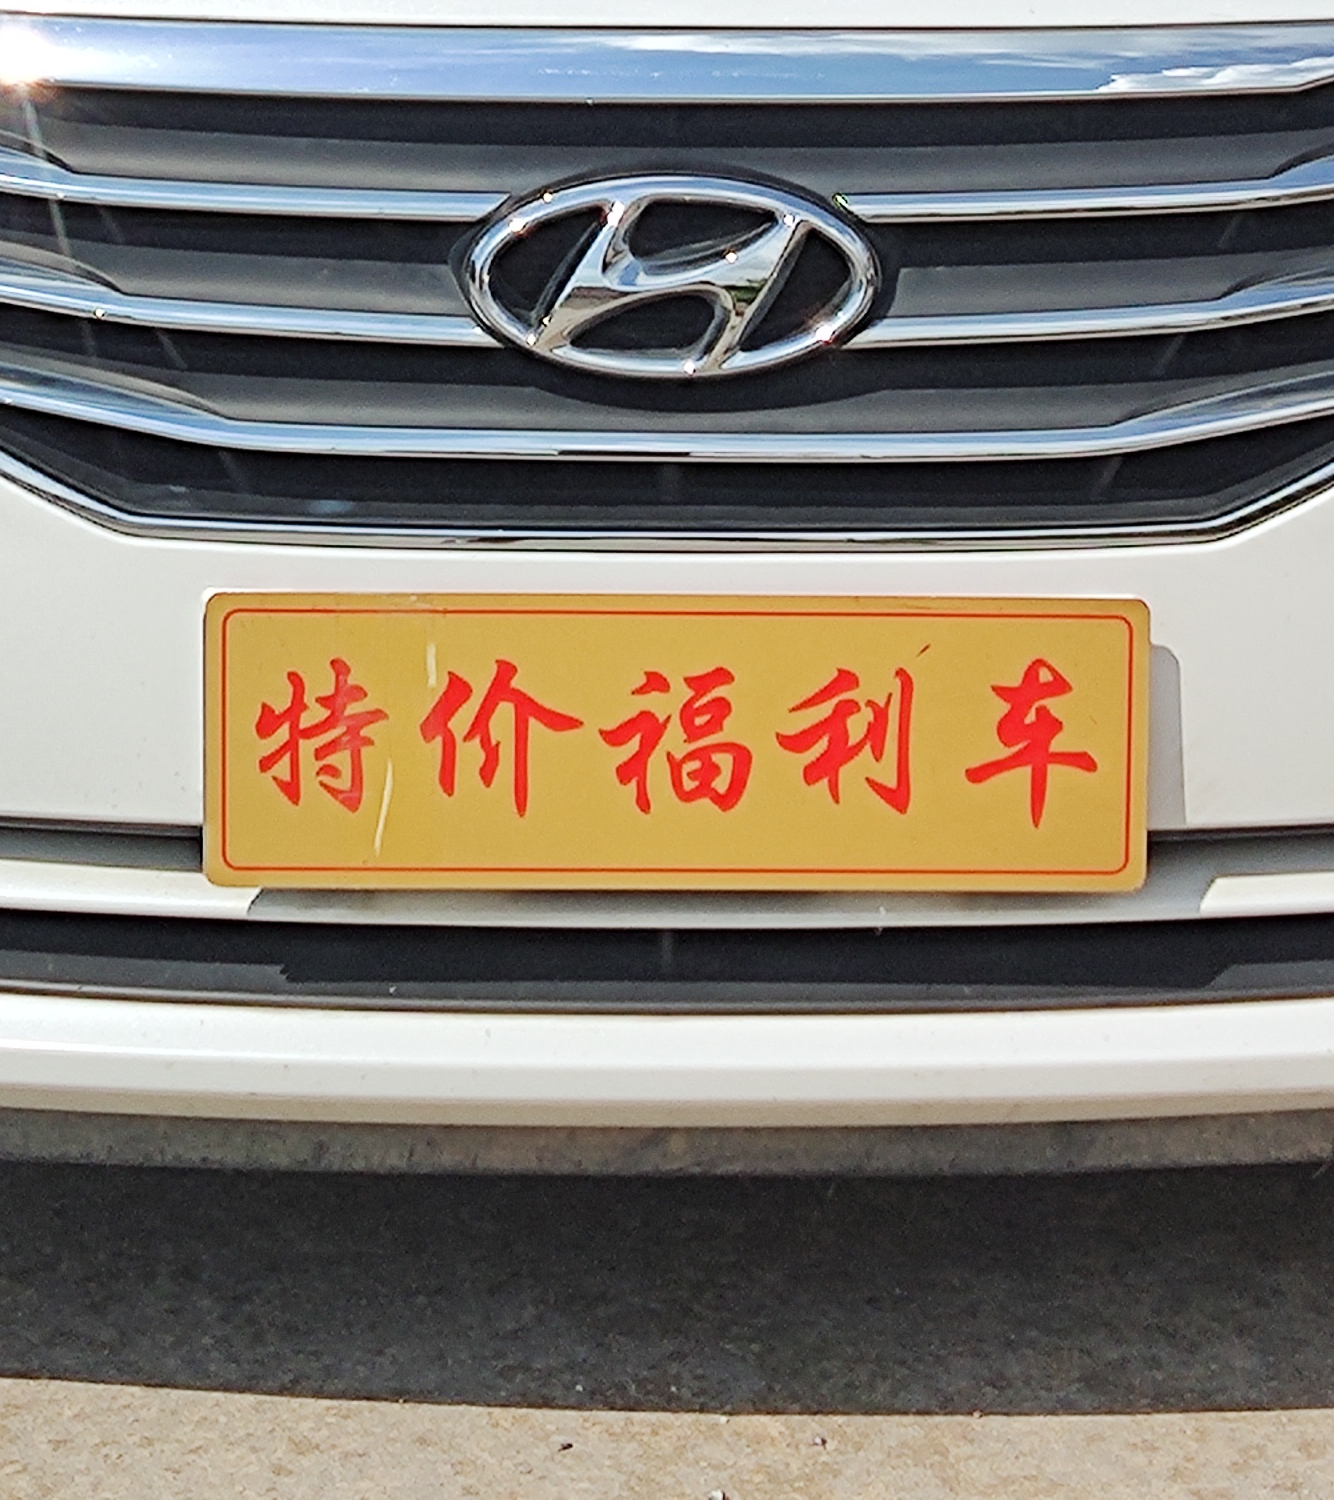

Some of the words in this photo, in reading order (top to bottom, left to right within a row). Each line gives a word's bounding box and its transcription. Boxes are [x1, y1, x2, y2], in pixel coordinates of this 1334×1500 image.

[254, 657, 1099, 830] 特价福利车
